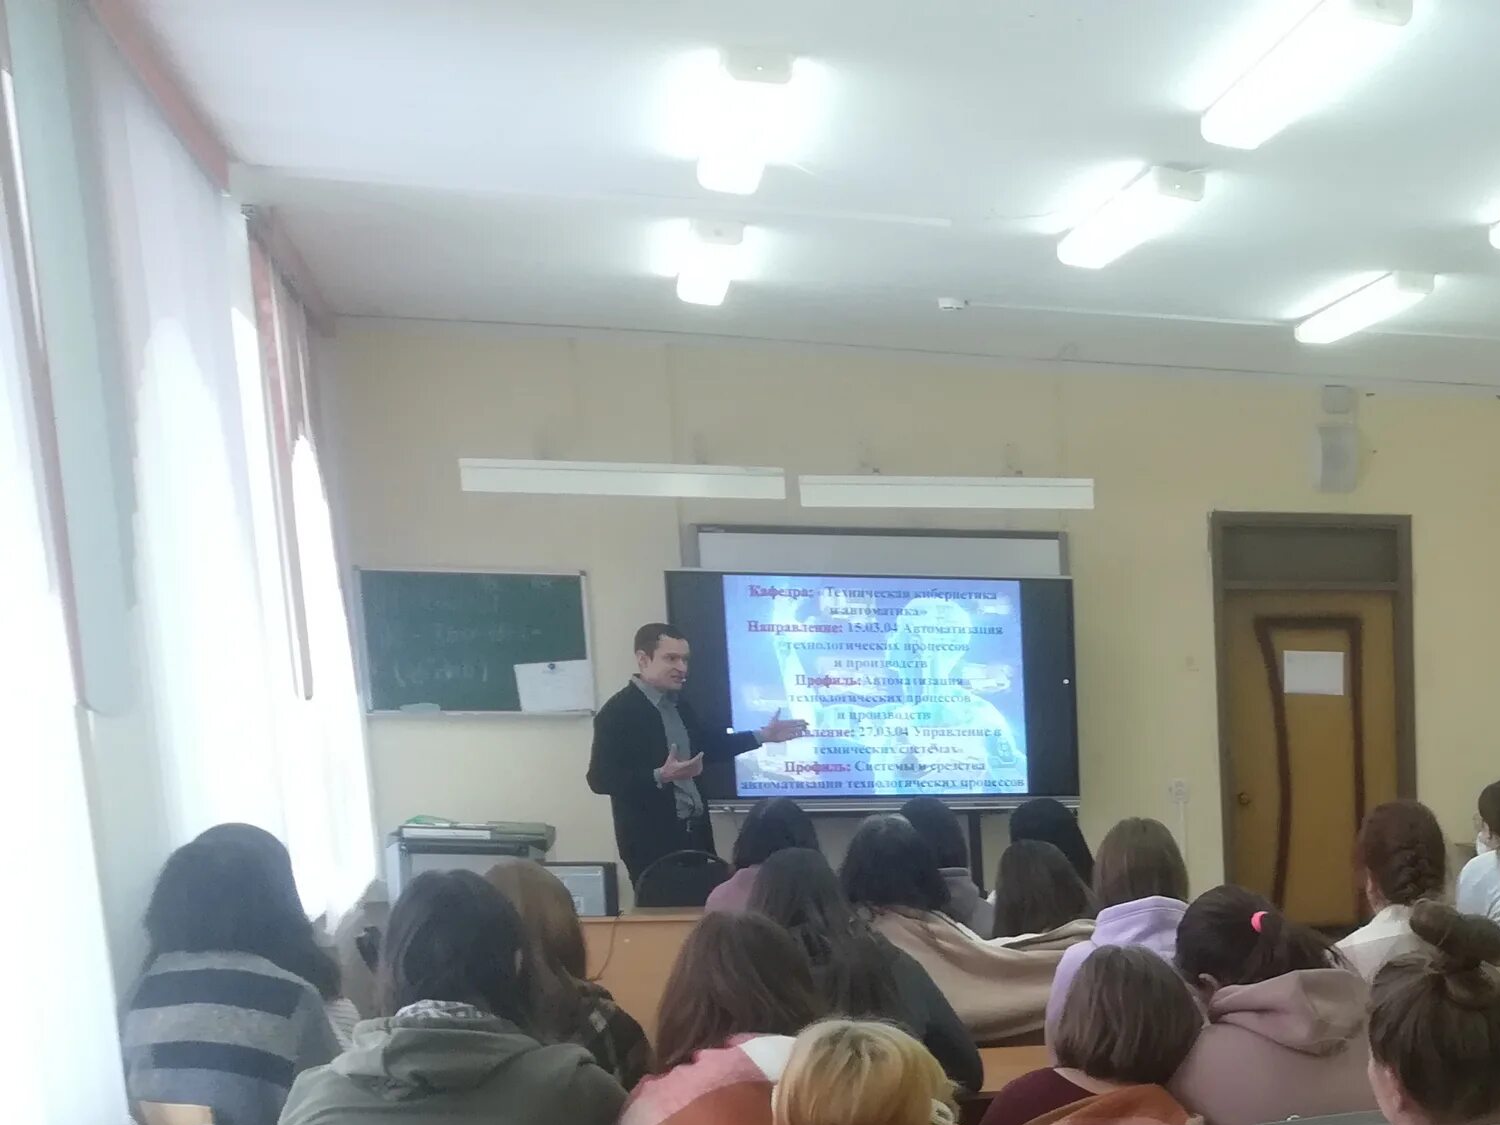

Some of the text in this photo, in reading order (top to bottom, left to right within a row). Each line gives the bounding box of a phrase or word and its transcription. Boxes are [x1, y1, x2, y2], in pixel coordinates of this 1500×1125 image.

[748, 585, 814, 600] Кафедра:
[913, 588, 998, 602] кибернетика
[747, 620, 1004, 636] Направление: 15.03.04 Автоматизация
[786, 641, 970, 654] технологических процессов
[846, 659, 928, 671] производств
[795, 674, 861, 689] Профиль:
[789, 693, 971, 706] технологических процессов
[848, 710, 931, 723] производств
[858, 726, 909, 738] 27.03.04
[913, 727, 992, 741] Управление
[784, 761, 851, 775] Профиль:
[854, 760, 915, 773] Системы
[740, 779, 1025, 791] автоматизации технологических процессов
